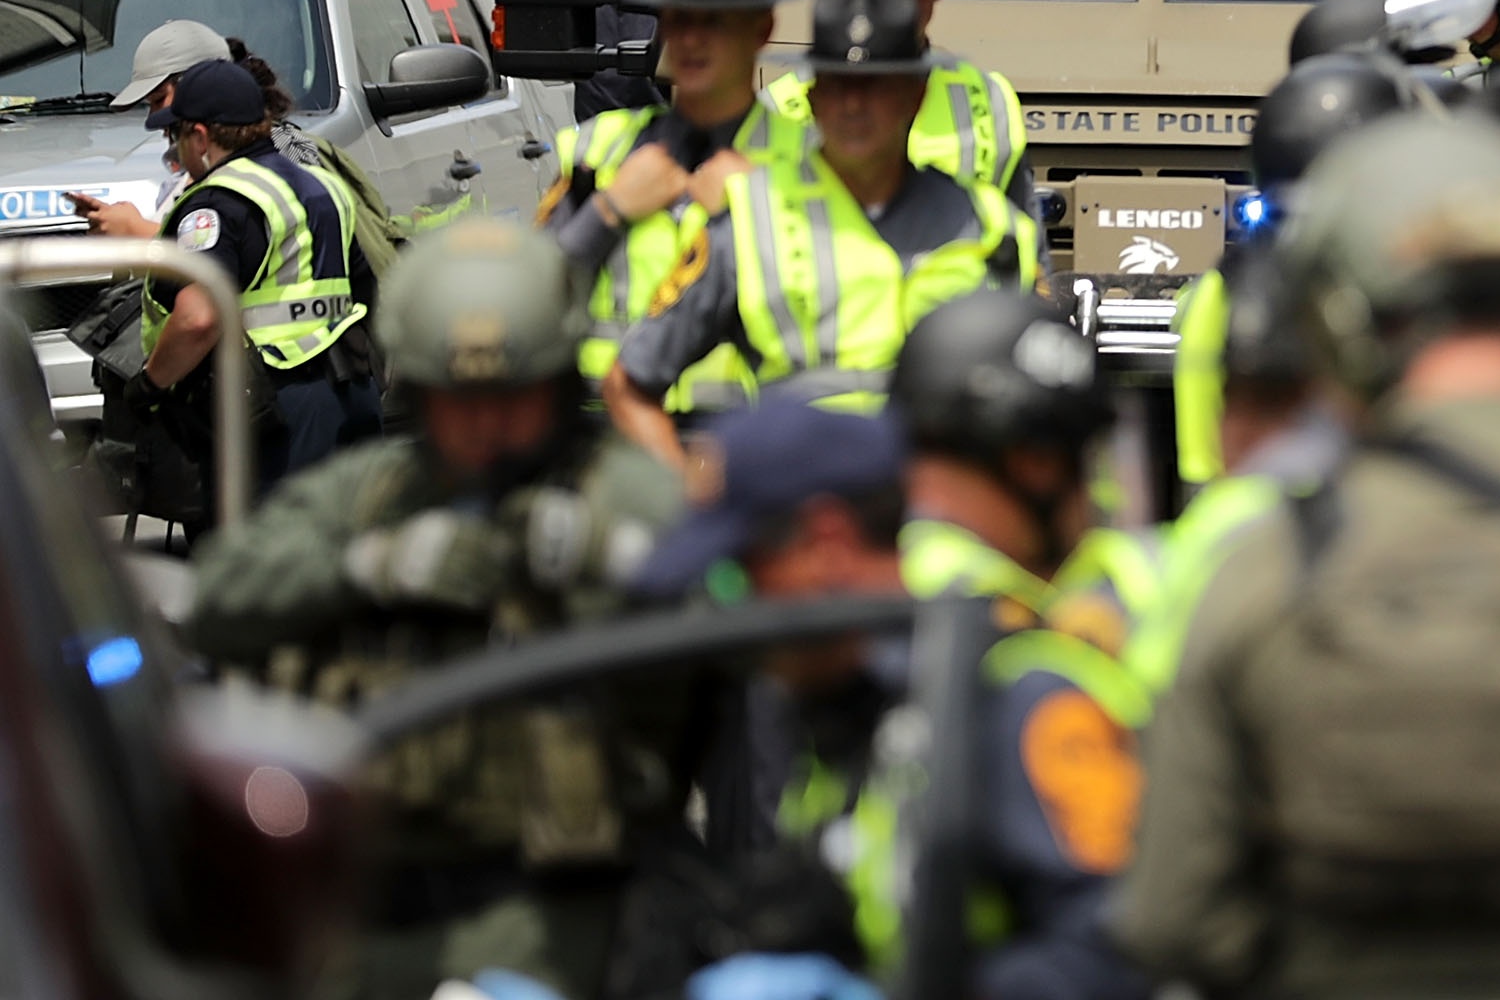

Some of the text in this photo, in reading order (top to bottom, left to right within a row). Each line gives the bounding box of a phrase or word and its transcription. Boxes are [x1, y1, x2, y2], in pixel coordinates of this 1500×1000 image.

[1025, 111, 1255, 134] STATE POLIC
[1098, 209, 1203, 229] LENCO
[289, 296, 353, 321] POLIC
